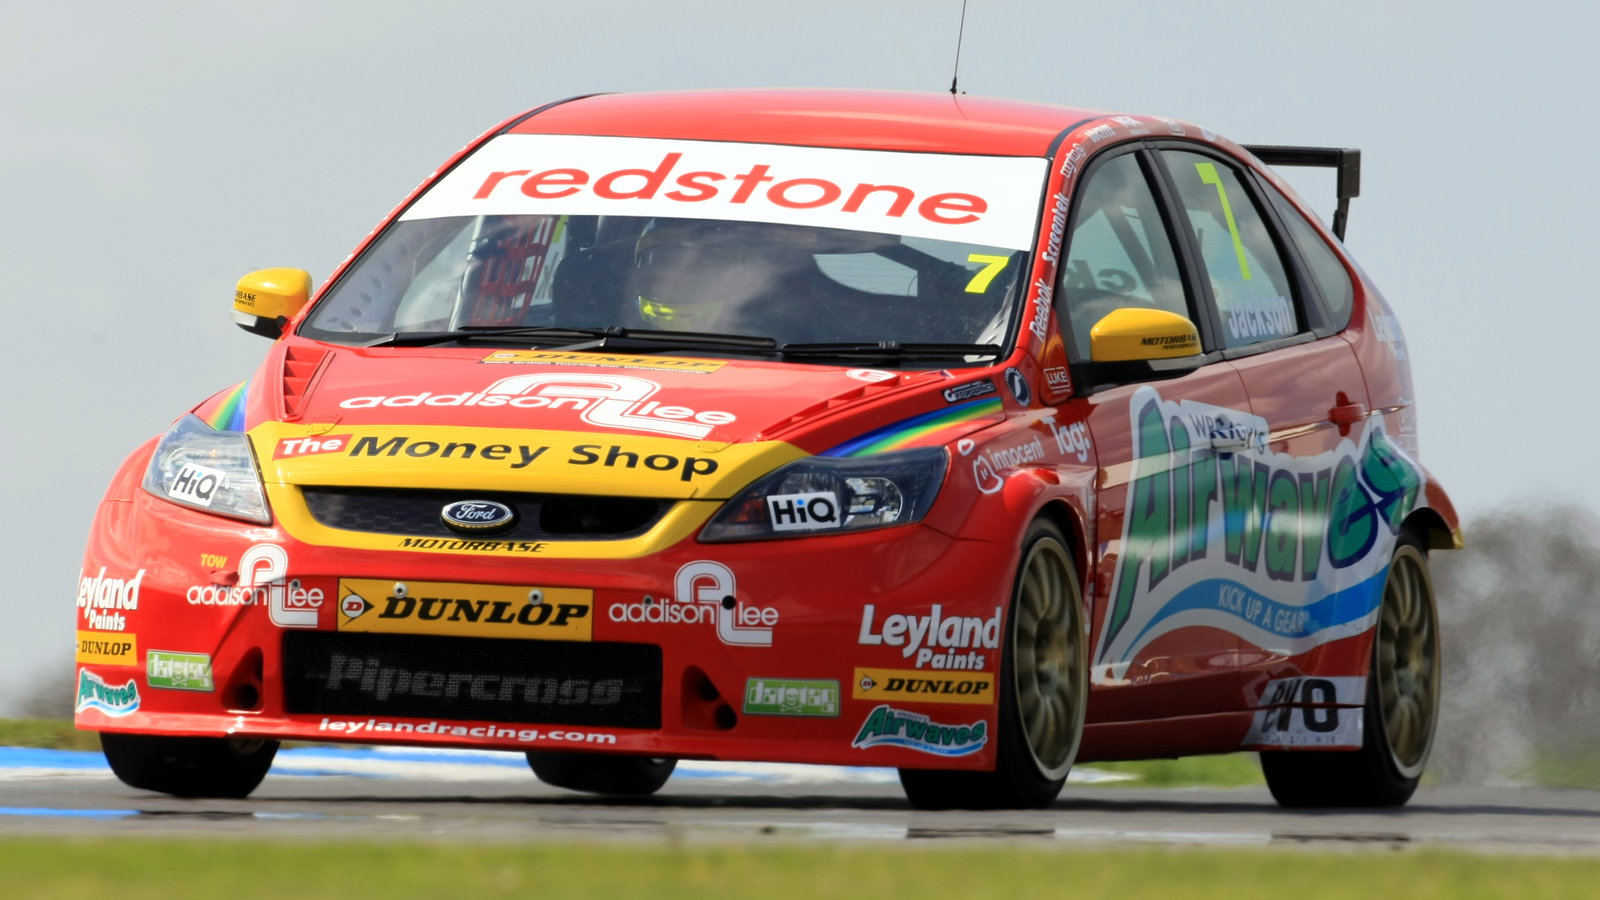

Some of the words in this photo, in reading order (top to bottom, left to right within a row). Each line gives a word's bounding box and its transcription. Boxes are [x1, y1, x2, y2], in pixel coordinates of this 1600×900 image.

[471, 152, 989, 226] redstone
[1041, 191, 1070, 268] Screentek
[1193, 162, 1252, 280] 7
[964, 253, 1009, 294] 7
[1028, 277, 1053, 342] Reebok
[1228, 291, 1293, 340] Jackson
[533, 353, 722, 368] DUNLOP
[1046, 371, 1069, 385] LUKE
[339, 391, 602, 411] addison
[635, 400, 737, 425] lee
[281, 437, 344, 456] The
[348, 436, 551, 469] Money
[567, 443, 719, 482] Shop
[987, 436, 1045, 470] innocent
[173, 467, 217, 501] HiQ
[455, 504, 496, 521] Ford
[771, 496, 837, 525] HiQ
[398, 537, 549, 553] MOTORBASE
[1100, 397, 1422, 665] Airwaves
[201, 553, 228, 569] TOW
[186, 583, 268, 607] addison
[287, 581, 325, 608] lee
[1218, 583, 1246, 614] KICK
[1245, 595, 1262, 622] UP
[1262, 604, 1272, 629] A
[89, 608, 126, 632] Paints
[379, 596, 590, 627] DUNLOP
[608, 598, 715, 624] addison
[738, 600, 780, 626] lee
[857, 603, 1003, 660] Leyland
[81, 639, 132, 657] DUNLOP
[915, 647, 986, 671] Paints
[325, 651, 624, 706] Pipercross
[883, 677, 990, 696] DUNLOP
[318, 717, 617, 744] leylandracing.com
[853, 706, 987, 747] Airwaves
